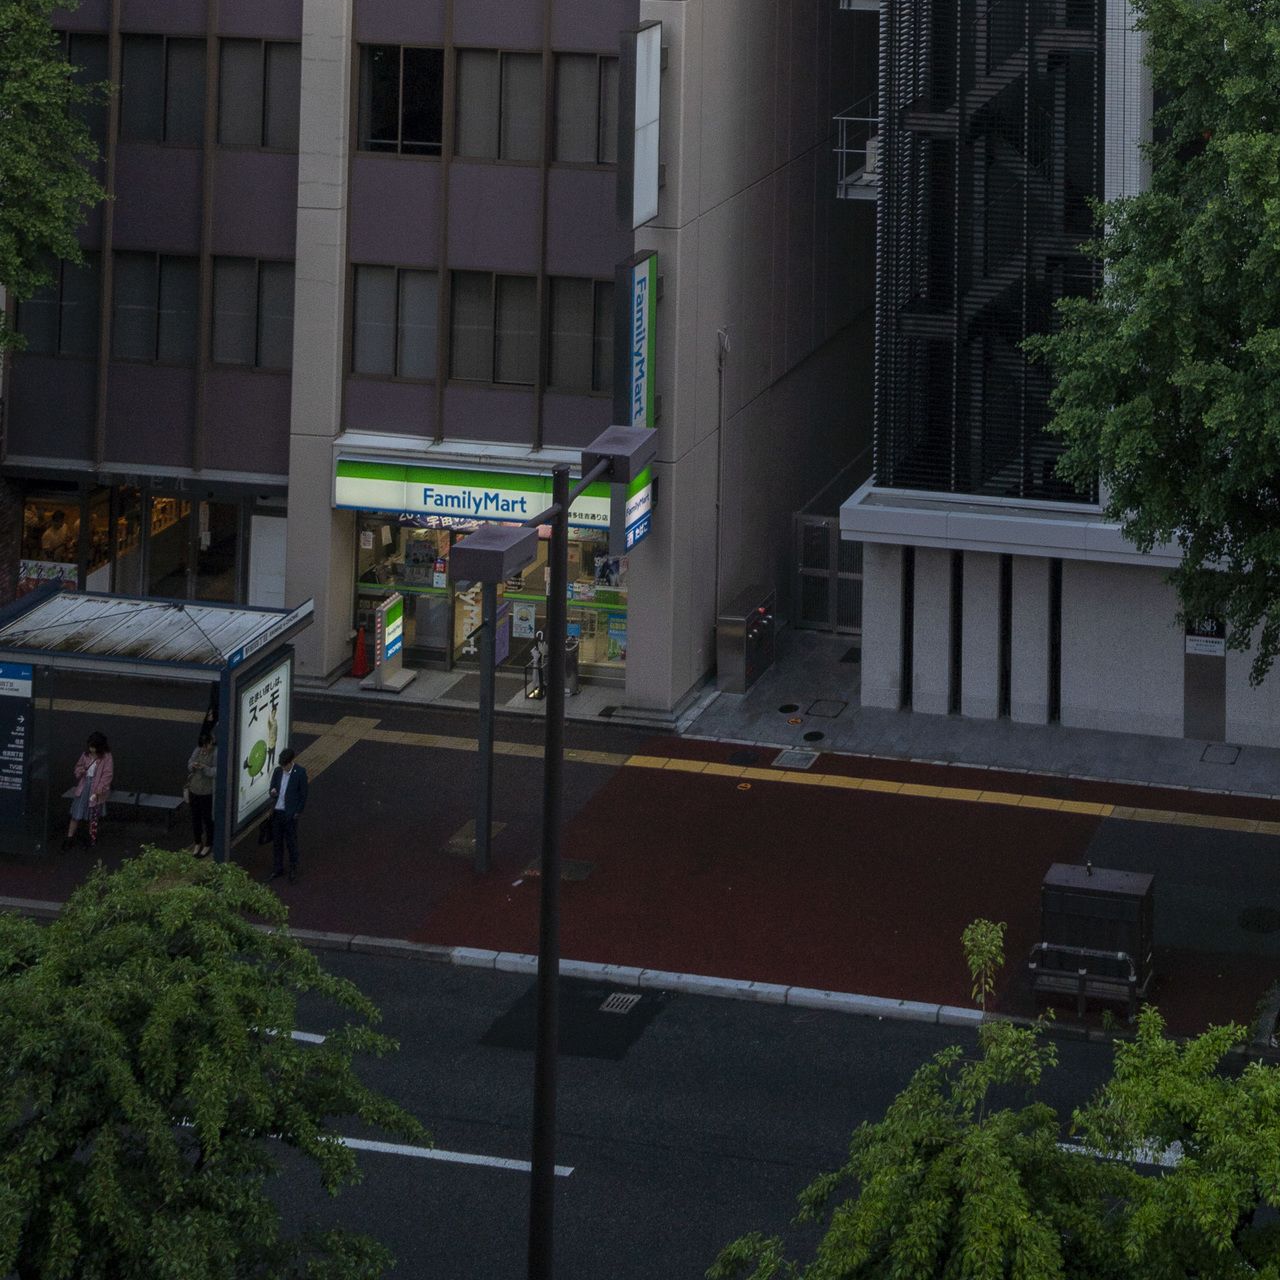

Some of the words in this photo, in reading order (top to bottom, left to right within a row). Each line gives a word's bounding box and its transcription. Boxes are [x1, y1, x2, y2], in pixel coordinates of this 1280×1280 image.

[634, 276, 647, 420] FamilyMart
[423, 487, 527, 515] FamilyMart
[248, 689, 280, 728] スーモ
